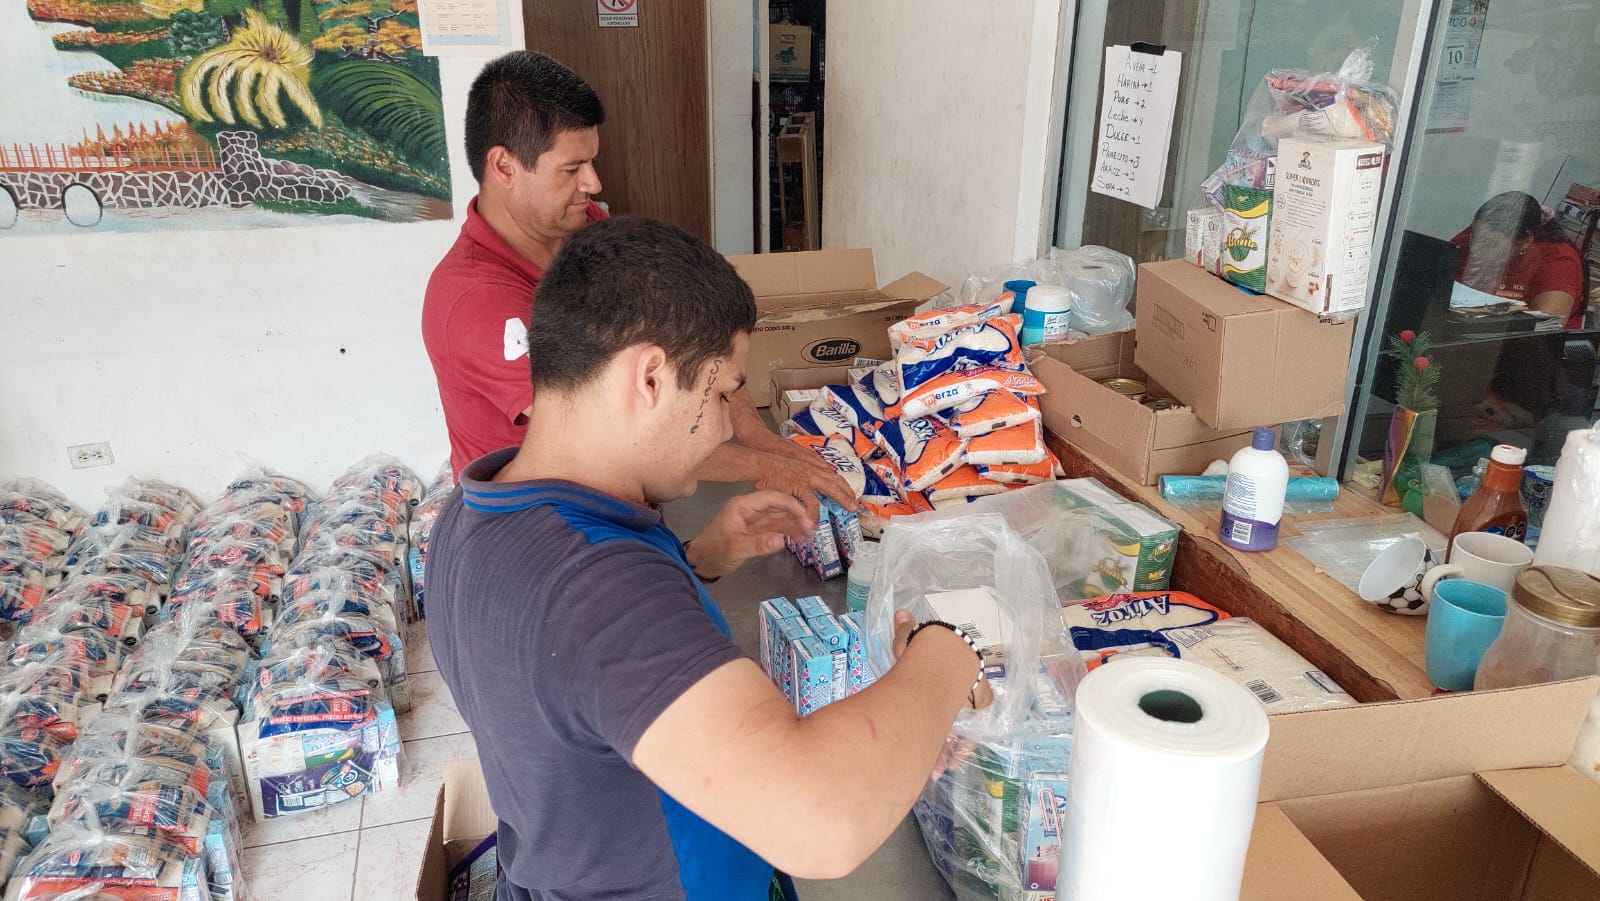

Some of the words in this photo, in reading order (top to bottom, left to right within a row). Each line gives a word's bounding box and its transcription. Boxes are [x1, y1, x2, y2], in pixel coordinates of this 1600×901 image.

[1448, 50, 1462, 64] 10
[816, 343, 856, 357] Barilla
[924, 388, 959, 406] merza
[1091, 594, 1170, 626] Arroz
